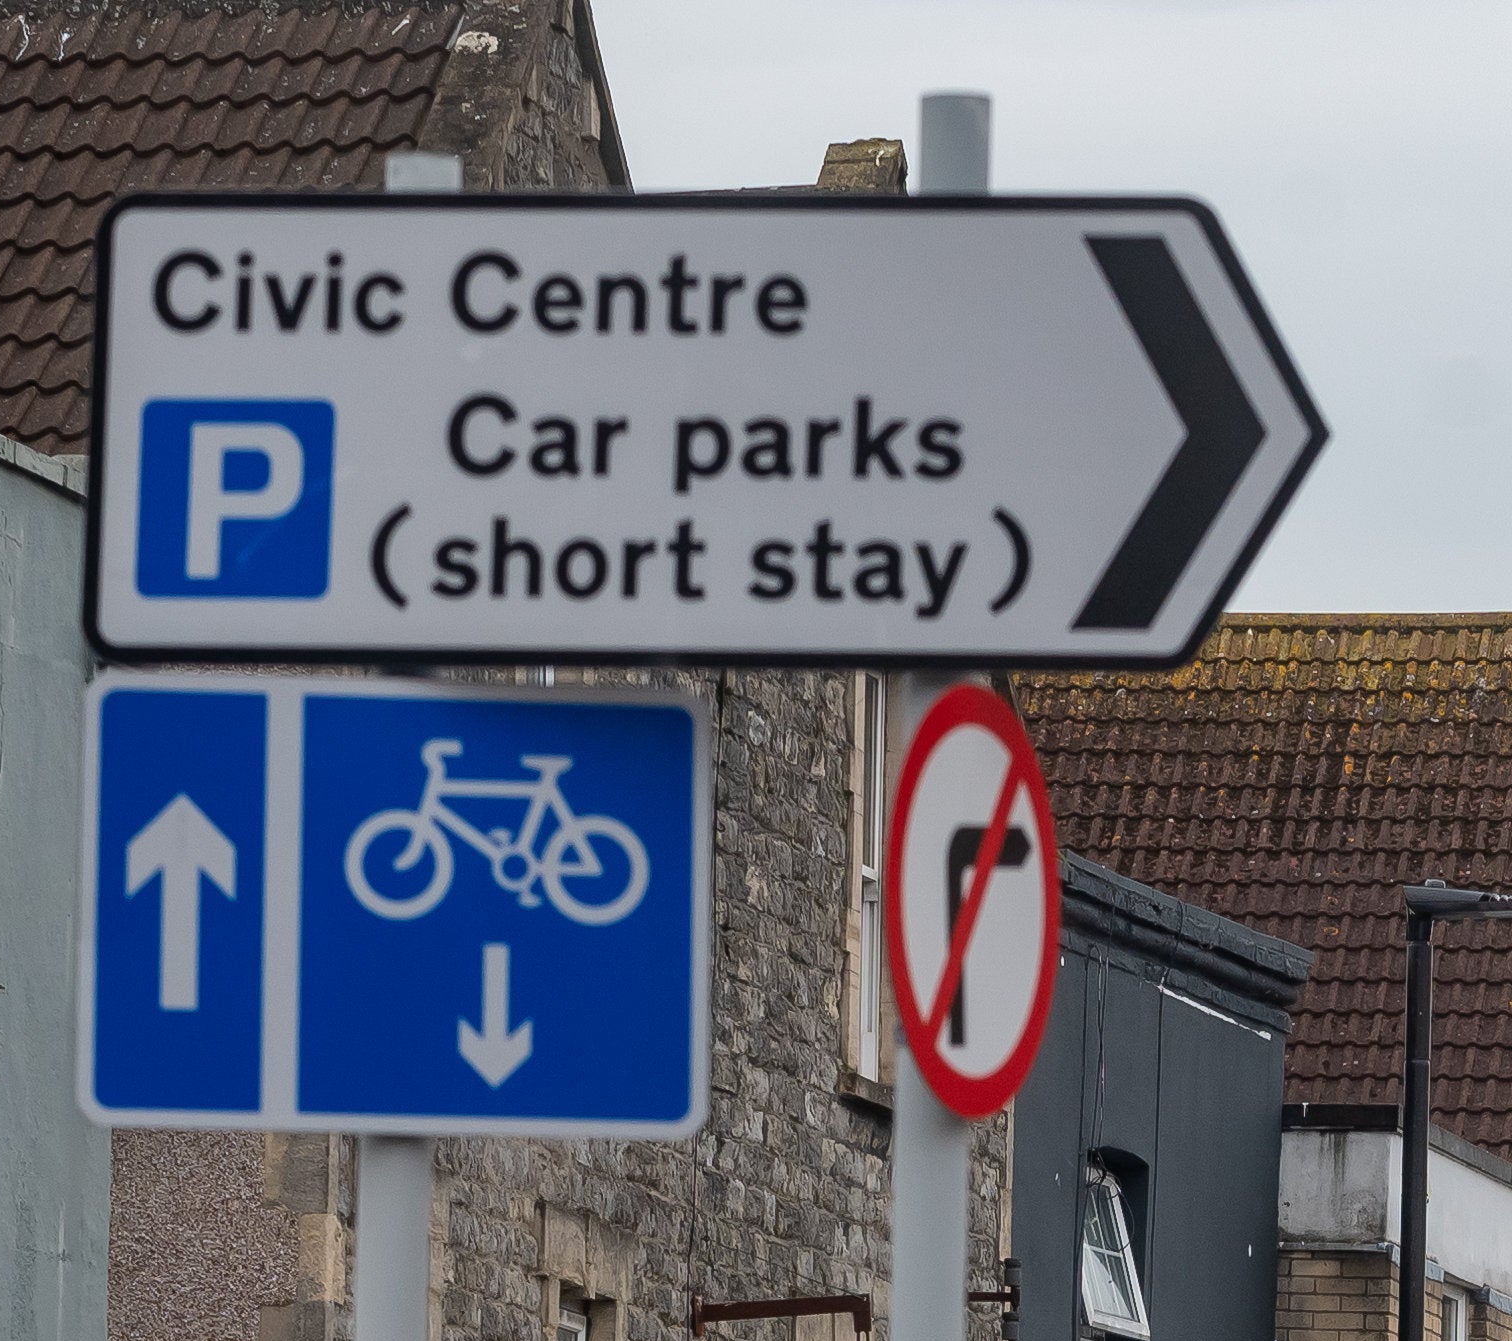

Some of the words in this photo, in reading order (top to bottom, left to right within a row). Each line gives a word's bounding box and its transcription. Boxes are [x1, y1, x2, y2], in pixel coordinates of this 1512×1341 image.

[153, 250, 406, 334] Civic
[451, 250, 809, 336] Centre
[448, 394, 628, 477] Car
[672, 396, 964, 496] parks
[185, 421, 305, 580] P
[371, 501, 707, 609] (short
[747, 504, 1032, 619] stay)
